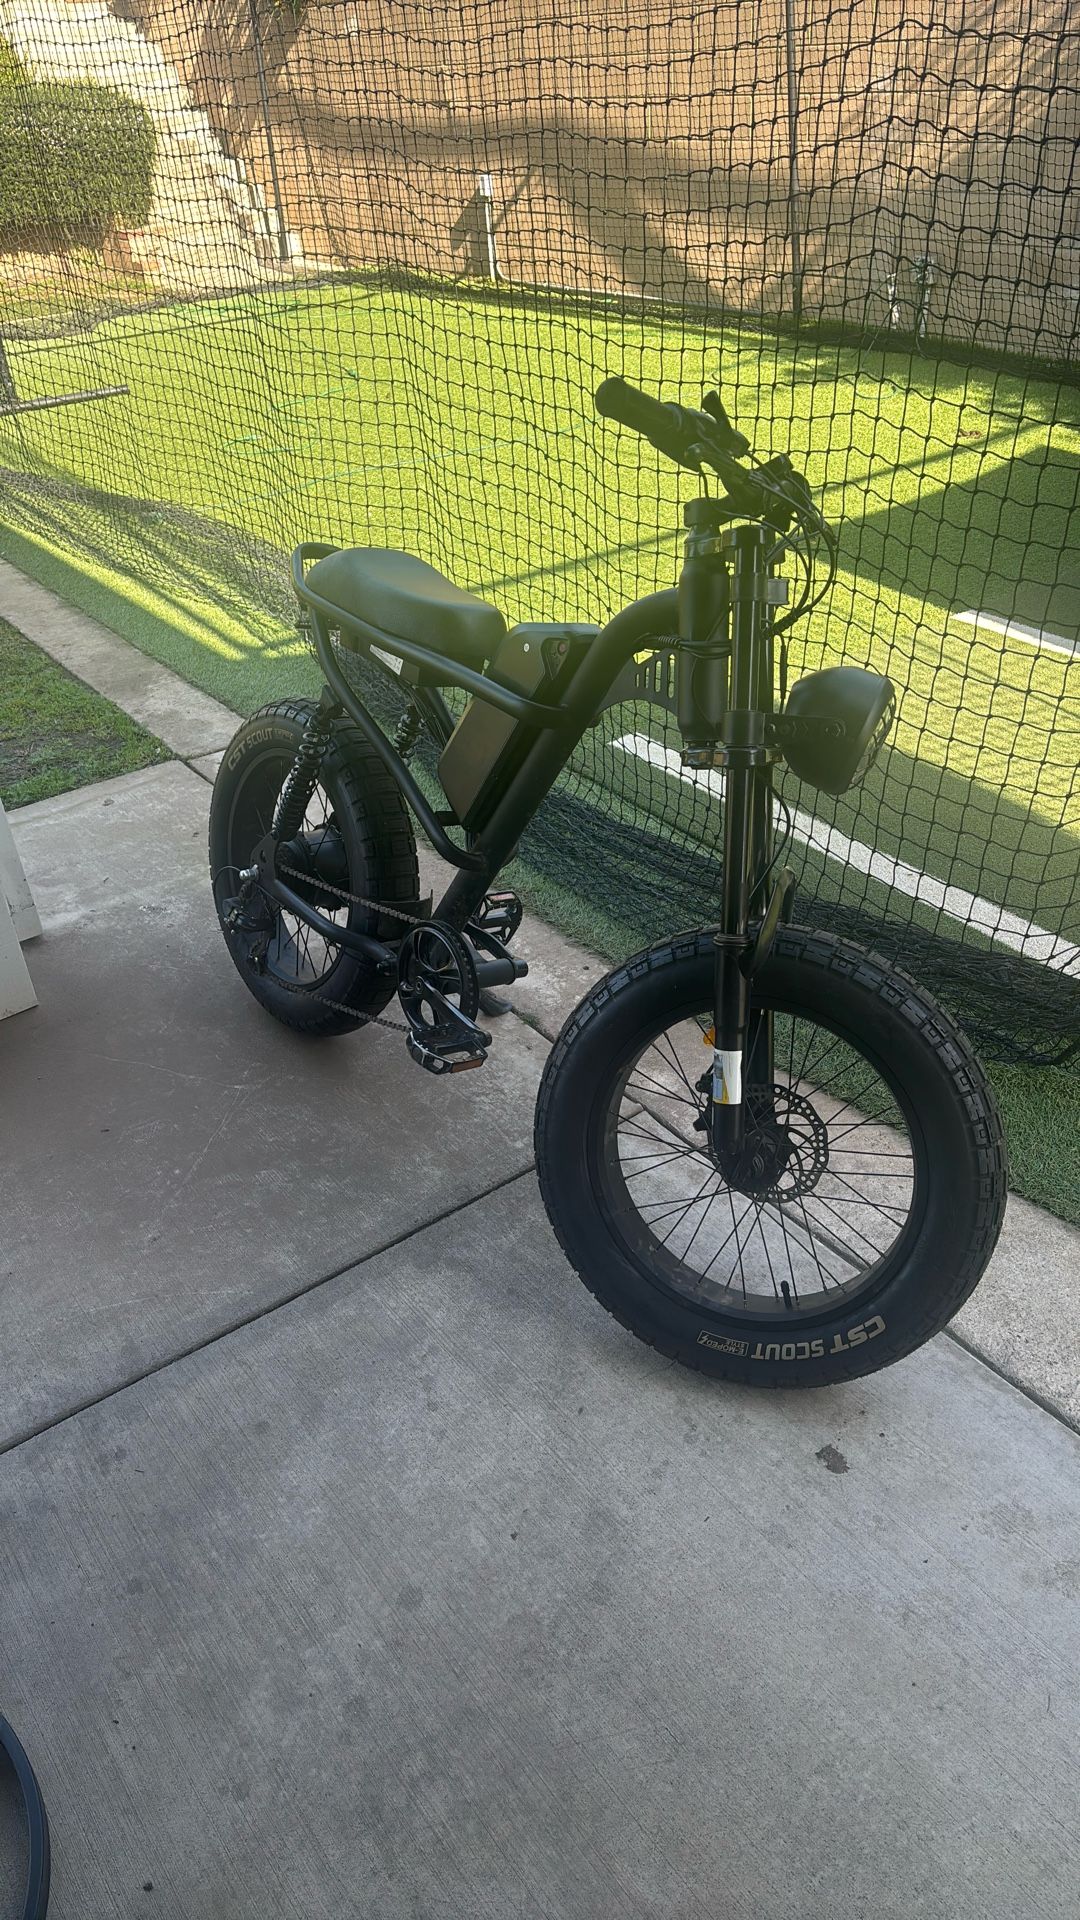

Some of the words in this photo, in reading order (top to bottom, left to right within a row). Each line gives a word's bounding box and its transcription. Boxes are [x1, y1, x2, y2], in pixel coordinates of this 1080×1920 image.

[228, 741, 246, 771] CST
[247, 728, 273, 749] SCOUT
[706, 1339, 745, 1356] E-MOPED
[751, 1339, 825, 1360] SCOUT
[830, 1315, 886, 1354] CST
